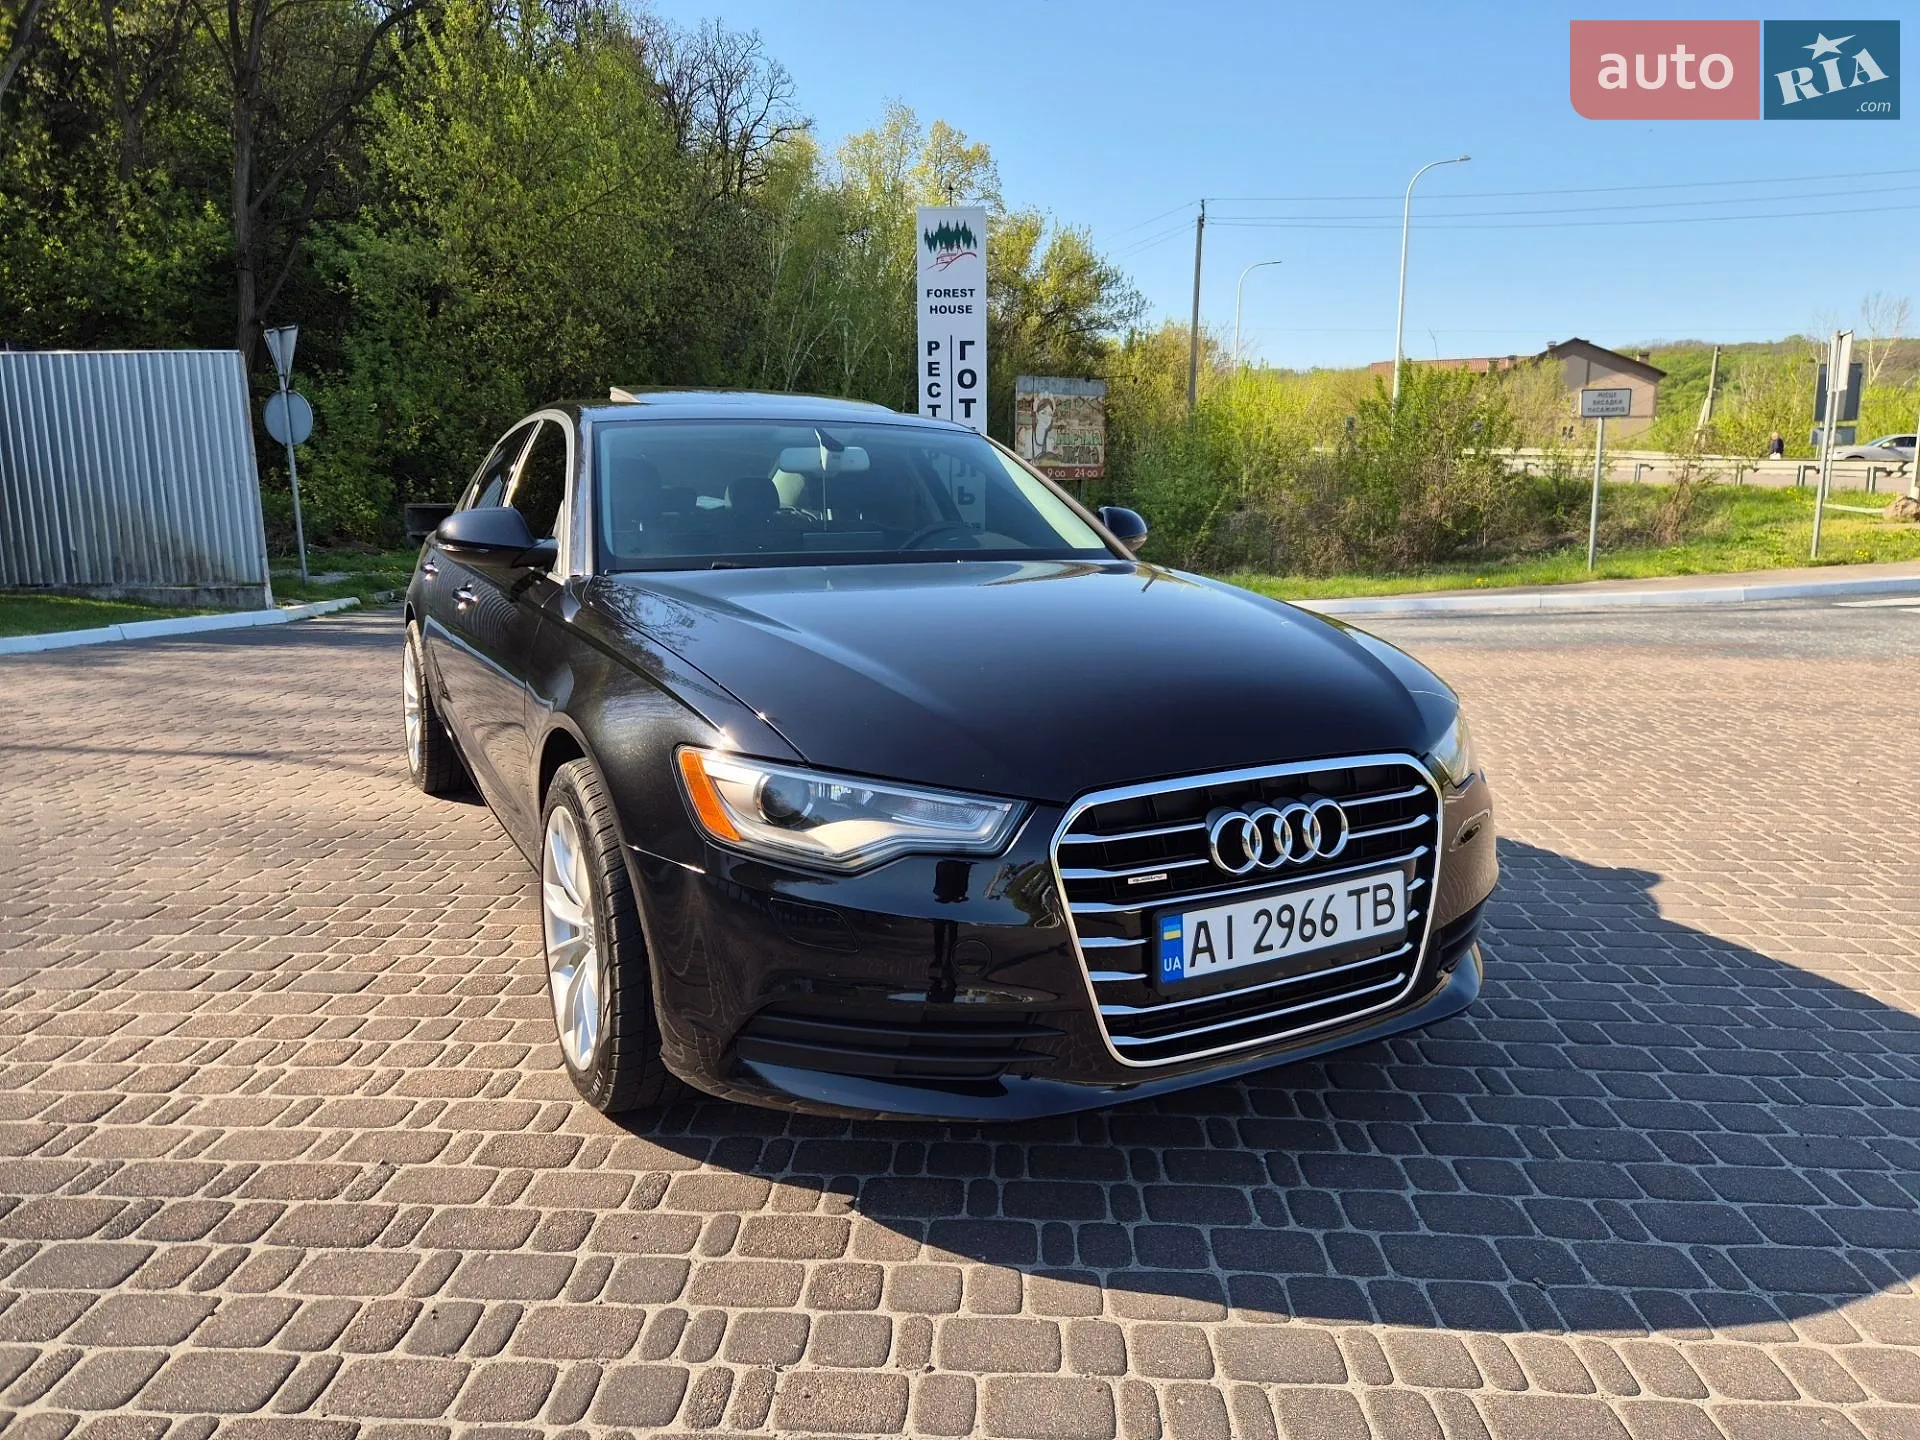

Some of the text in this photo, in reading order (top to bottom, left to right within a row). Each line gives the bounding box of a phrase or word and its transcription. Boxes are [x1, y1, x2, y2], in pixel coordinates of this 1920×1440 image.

[926, 288, 976, 298] FOREST
[929, 304, 973, 315] HOUSE
[1189, 882, 1396, 968] AI 2966 TB
[1163, 957, 1182, 972] UA
